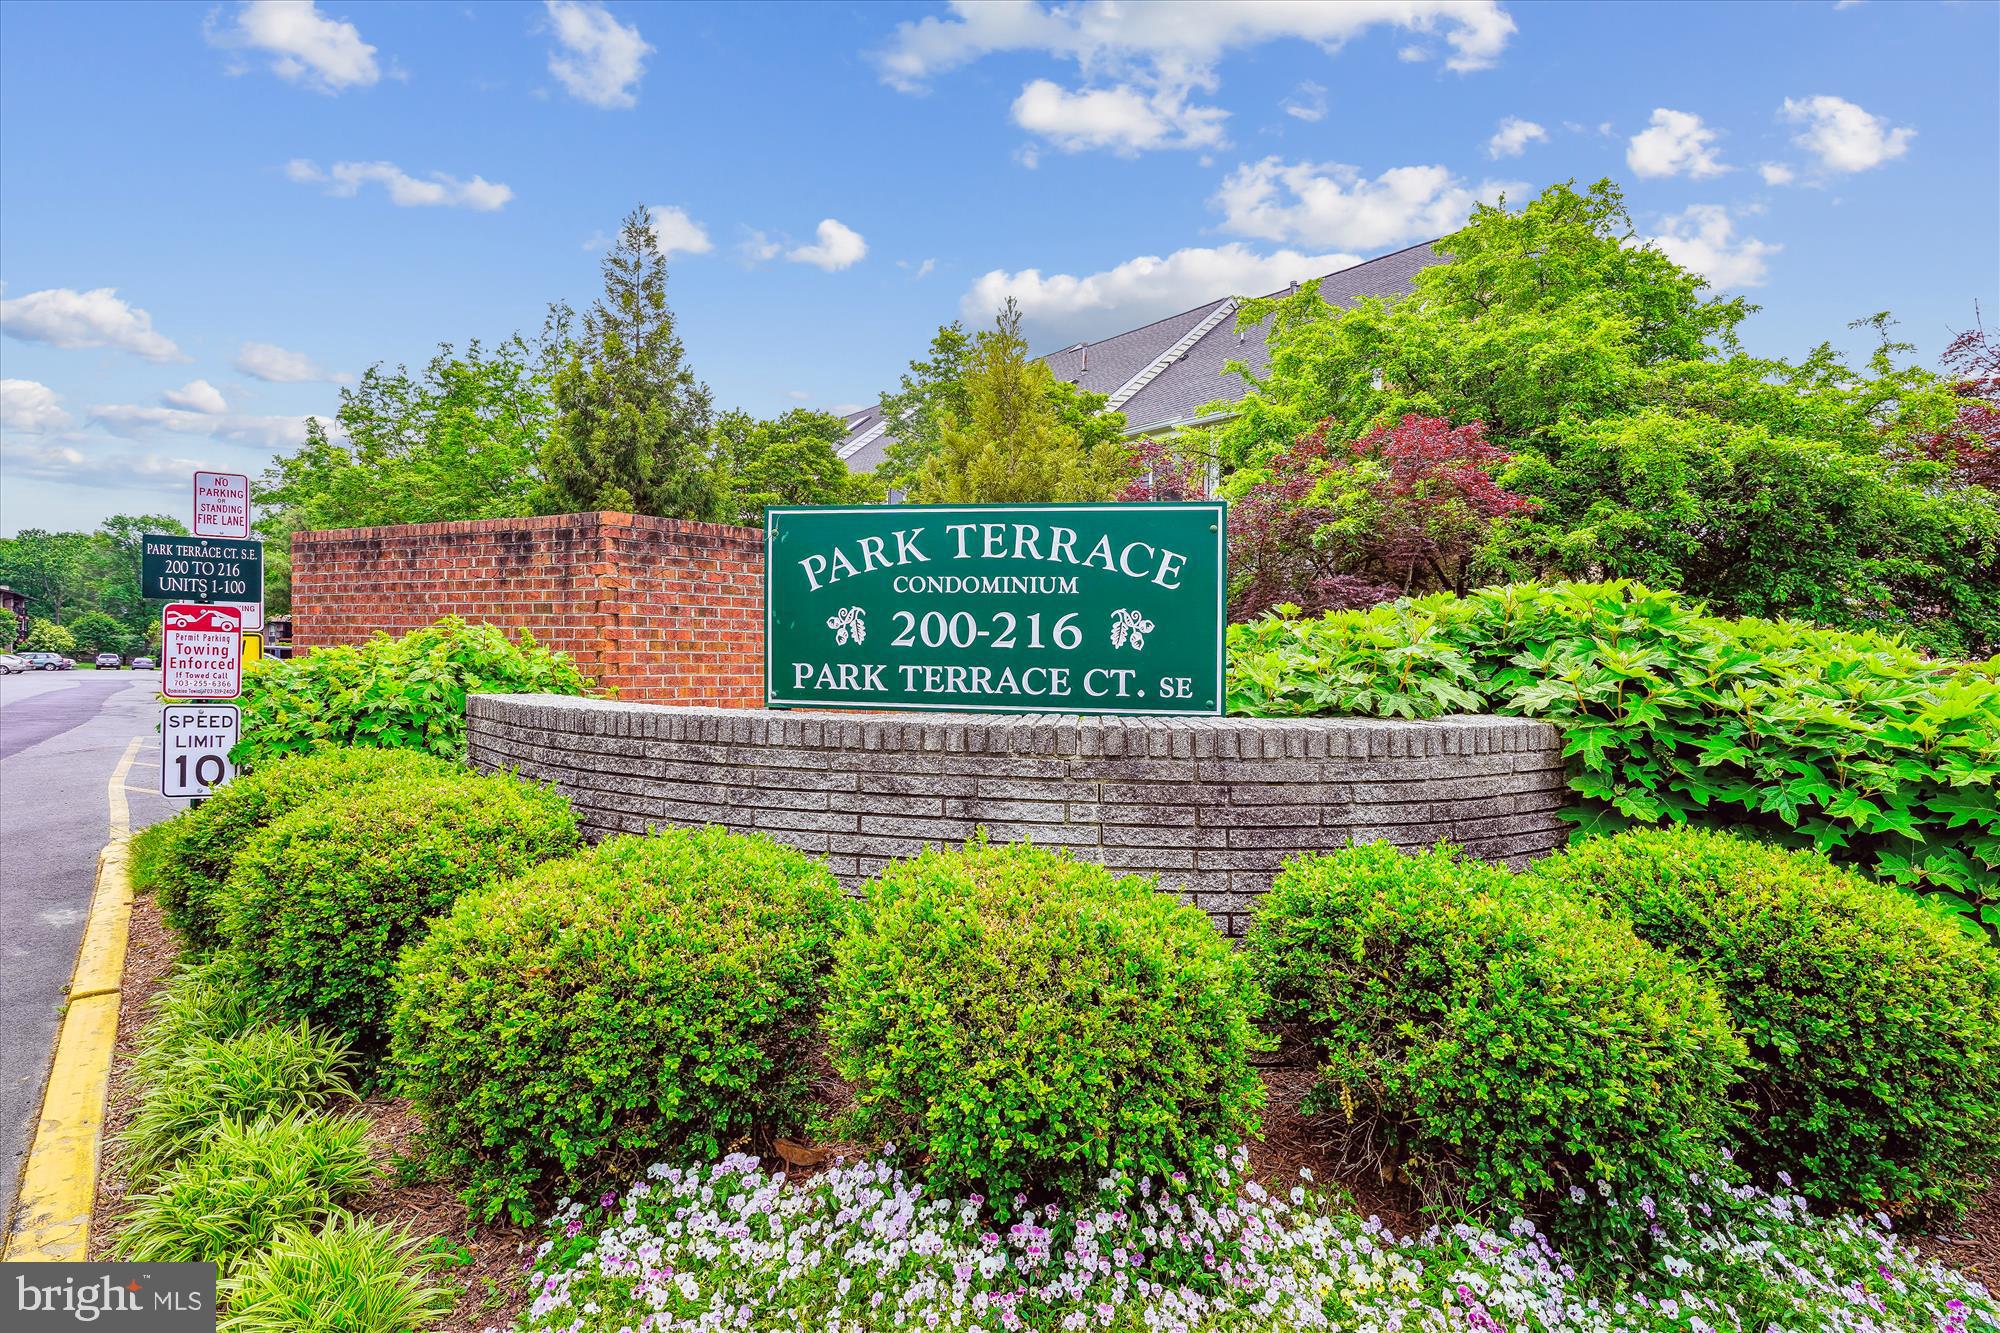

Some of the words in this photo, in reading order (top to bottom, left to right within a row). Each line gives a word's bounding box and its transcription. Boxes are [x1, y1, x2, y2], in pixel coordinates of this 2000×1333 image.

[214, 478, 228, 487] NO
[200, 488, 244, 498] PARKING
[200, 504, 242, 514] STANDING
[198, 514, 218, 524] FIRE
[222, 516, 244, 526] LANE
[147, 544, 173, 556] PARK
[176, 546, 222, 558] TERRACE
[224, 548, 238, 559] CT.
[241, 549, 258, 560] S.E.
[798, 529, 930, 592] PARK
[945, 523, 1187, 590] TERRACE
[165, 560, 188, 574] 200
[192, 562, 214, 576] TO
[218, 563, 240, 576] 216
[159, 577, 208, 592] UNITS
[212, 580, 246, 594] 1-100
[893, 576, 1079, 595] CONDOMINIUM
[891, 611, 1083, 650] 200-216
[176, 633, 200, 641] Permit
[203, 634, 230, 644] Parking
[176, 643, 228, 658] Towing
[170, 657, 234, 670] Enforced
[793, 663, 888, 691] PARK
[899, 666, 1071, 695] TERRACE
[1083, 669, 1145, 698] CT.
[1159, 677, 1193, 699] SE
[169, 716, 233, 728] SPEED
[176, 736, 226, 748] LIMIT
[176, 754, 225, 788] 10
